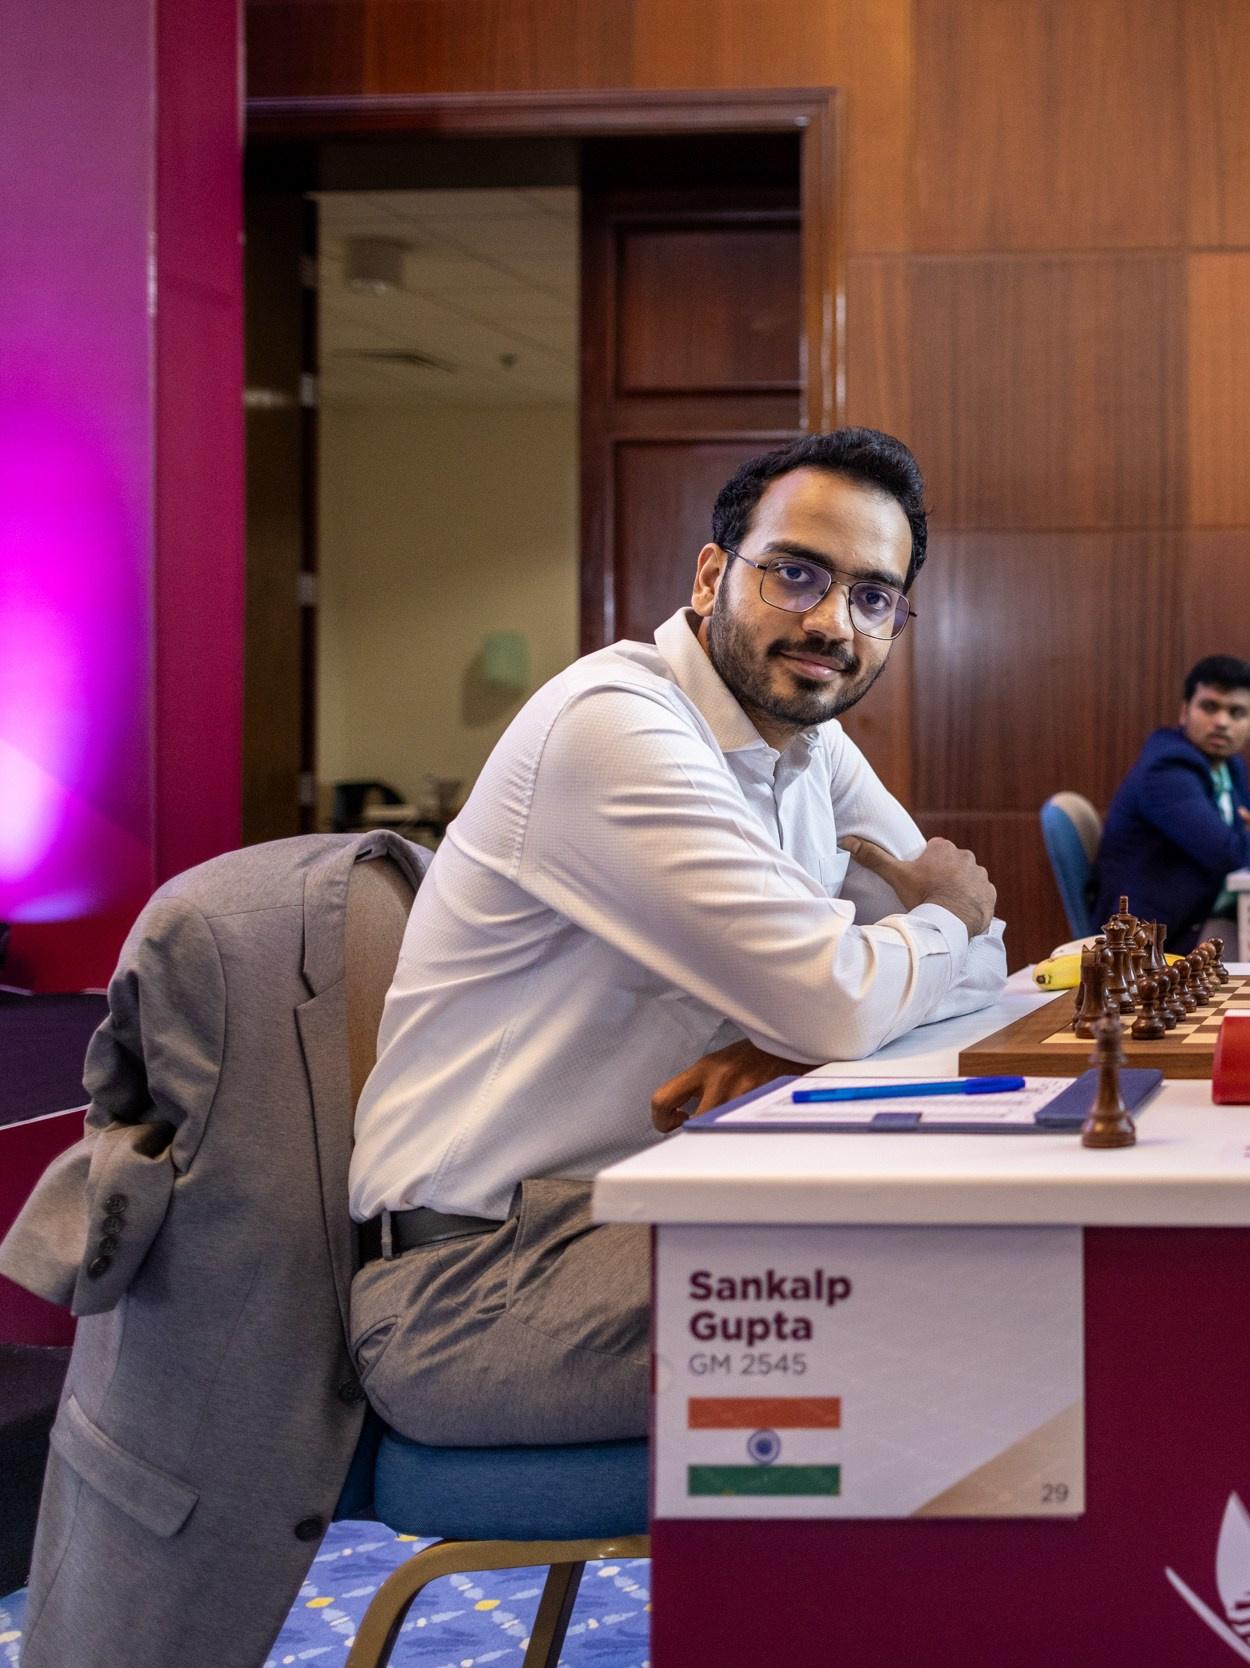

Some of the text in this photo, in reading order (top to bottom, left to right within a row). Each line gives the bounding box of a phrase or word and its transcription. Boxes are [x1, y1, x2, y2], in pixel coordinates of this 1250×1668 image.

[689, 1268, 852, 1307] Sankalp
[689, 1310, 813, 1348] Gupta
[688, 1353, 808, 1376] GM 2545
[1040, 1483, 1070, 1504] 29
